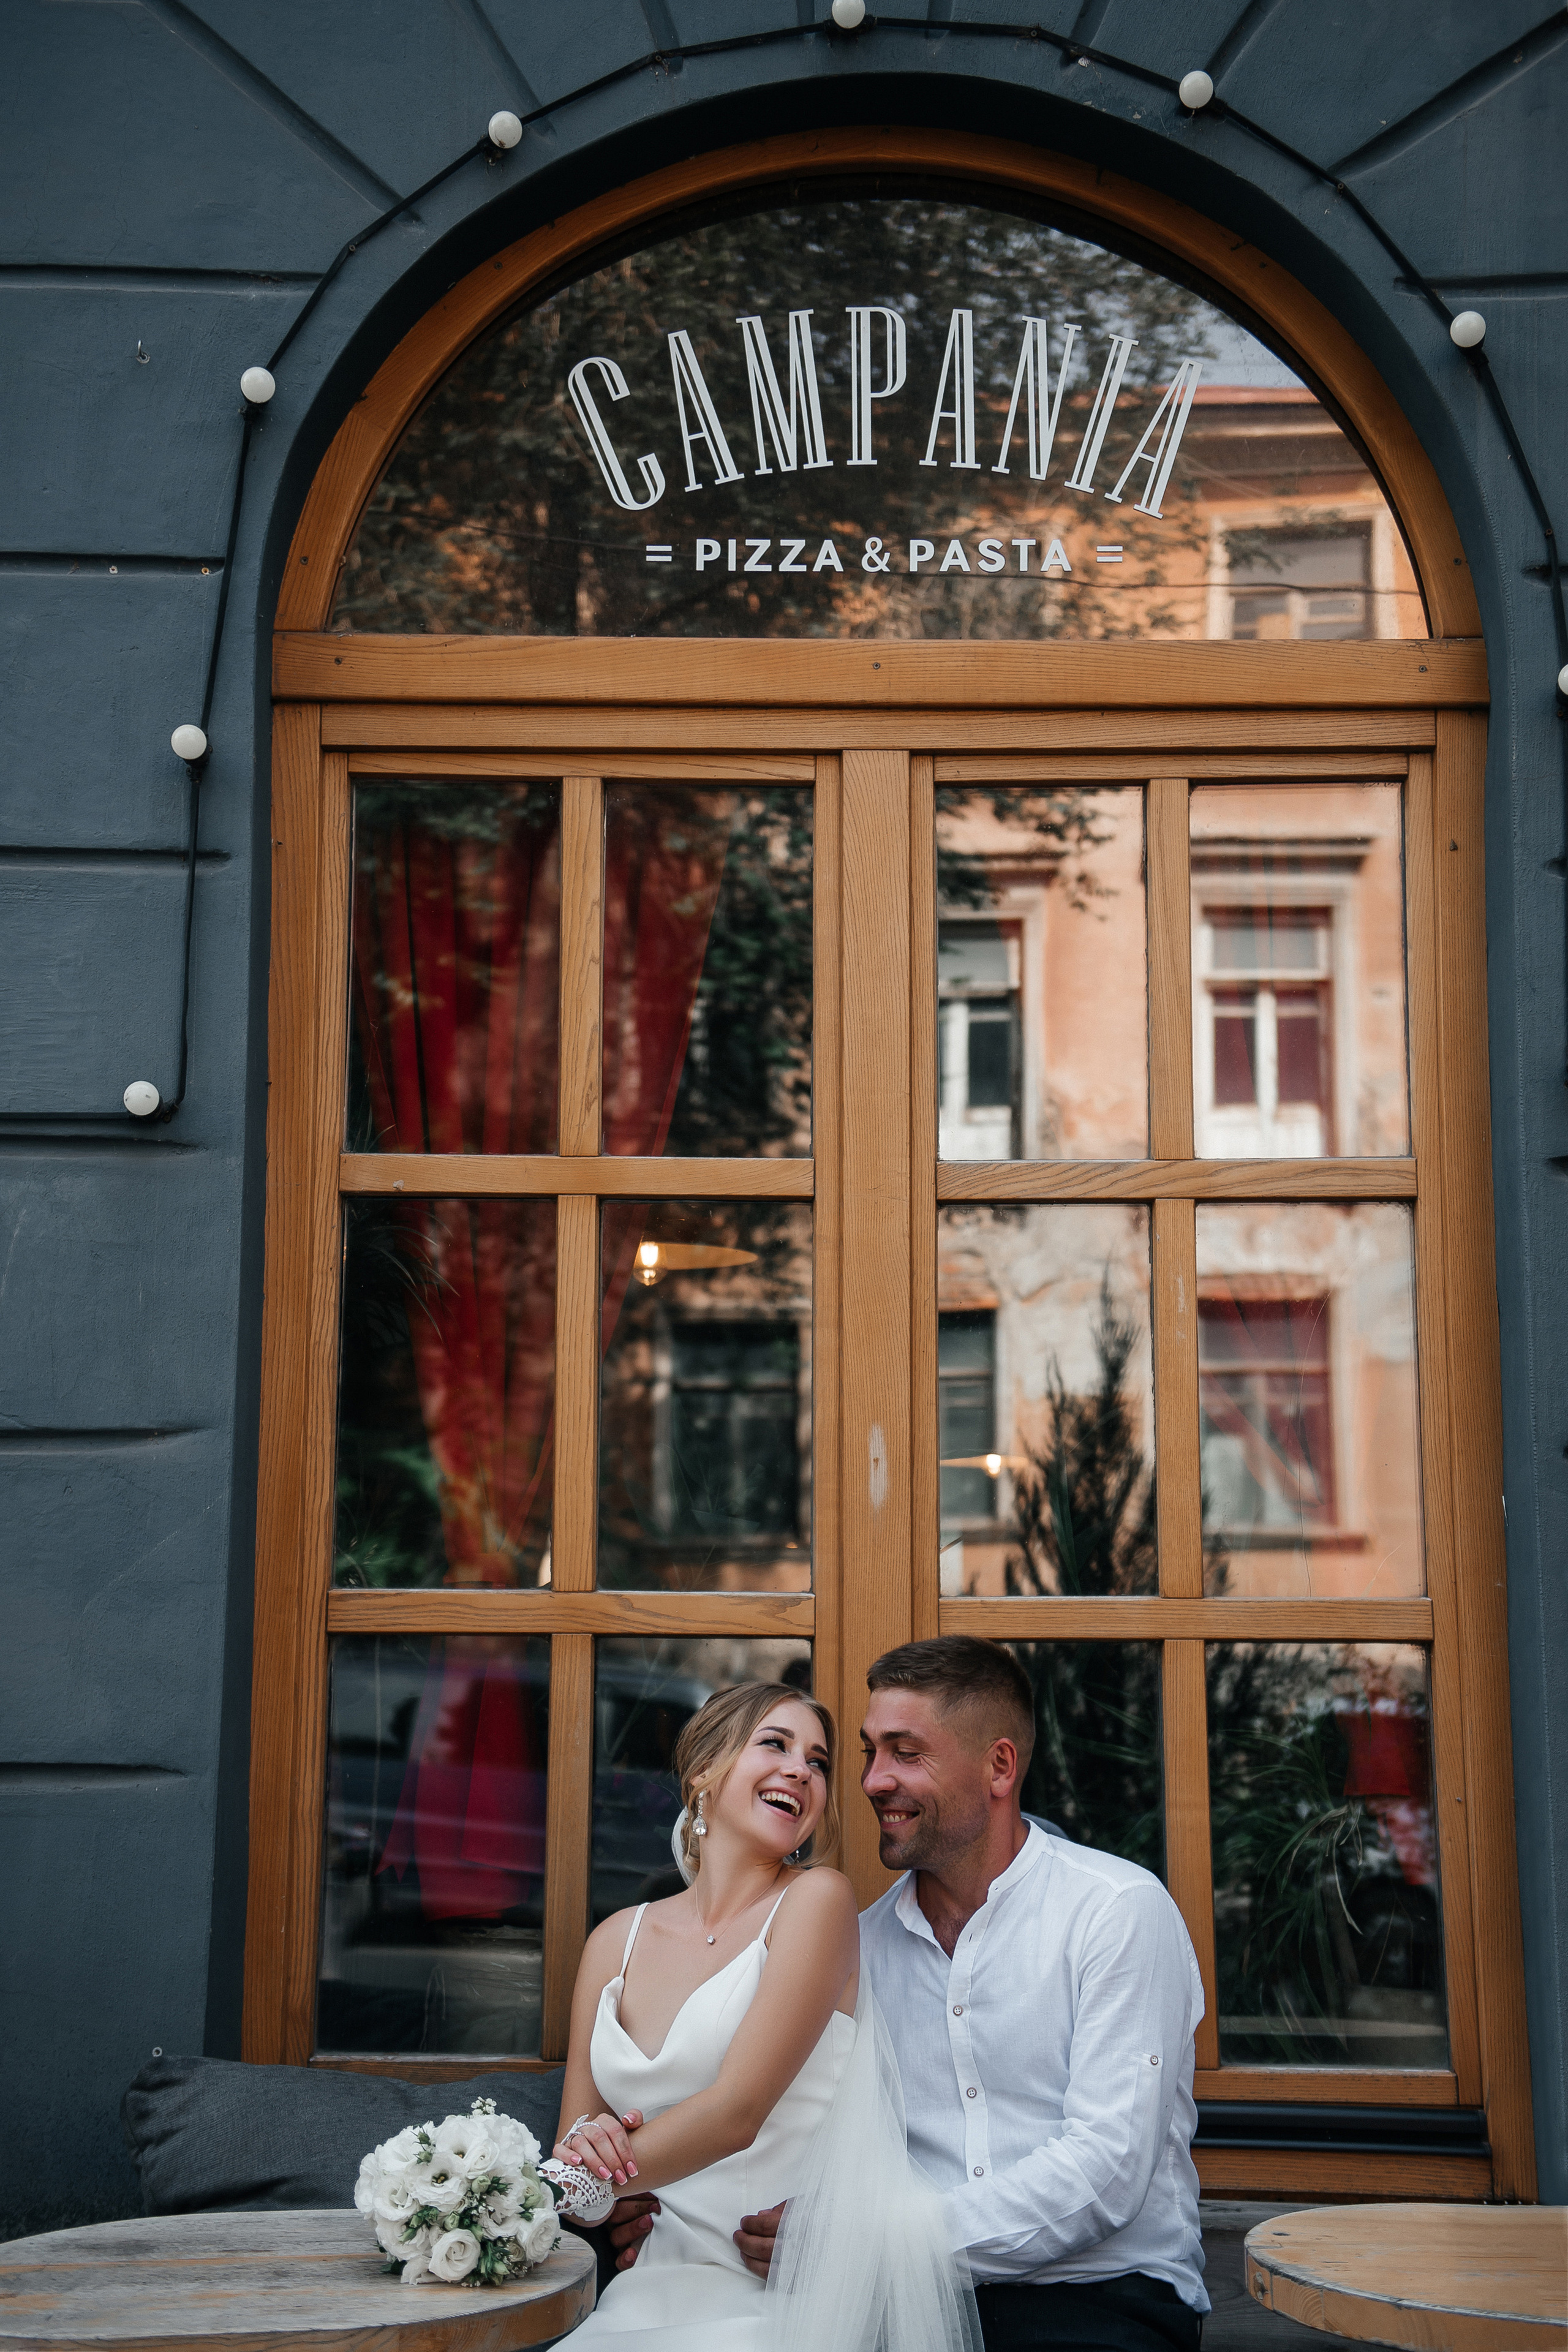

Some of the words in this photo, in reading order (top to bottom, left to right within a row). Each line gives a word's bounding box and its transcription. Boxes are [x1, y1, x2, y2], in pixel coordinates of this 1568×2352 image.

[568, 307, 1203, 519] CAMPANIA
[695, 538, 844, 572] PIZZA
[861, 537, 890, 573] &
[909, 538, 1072, 572] PASTA
